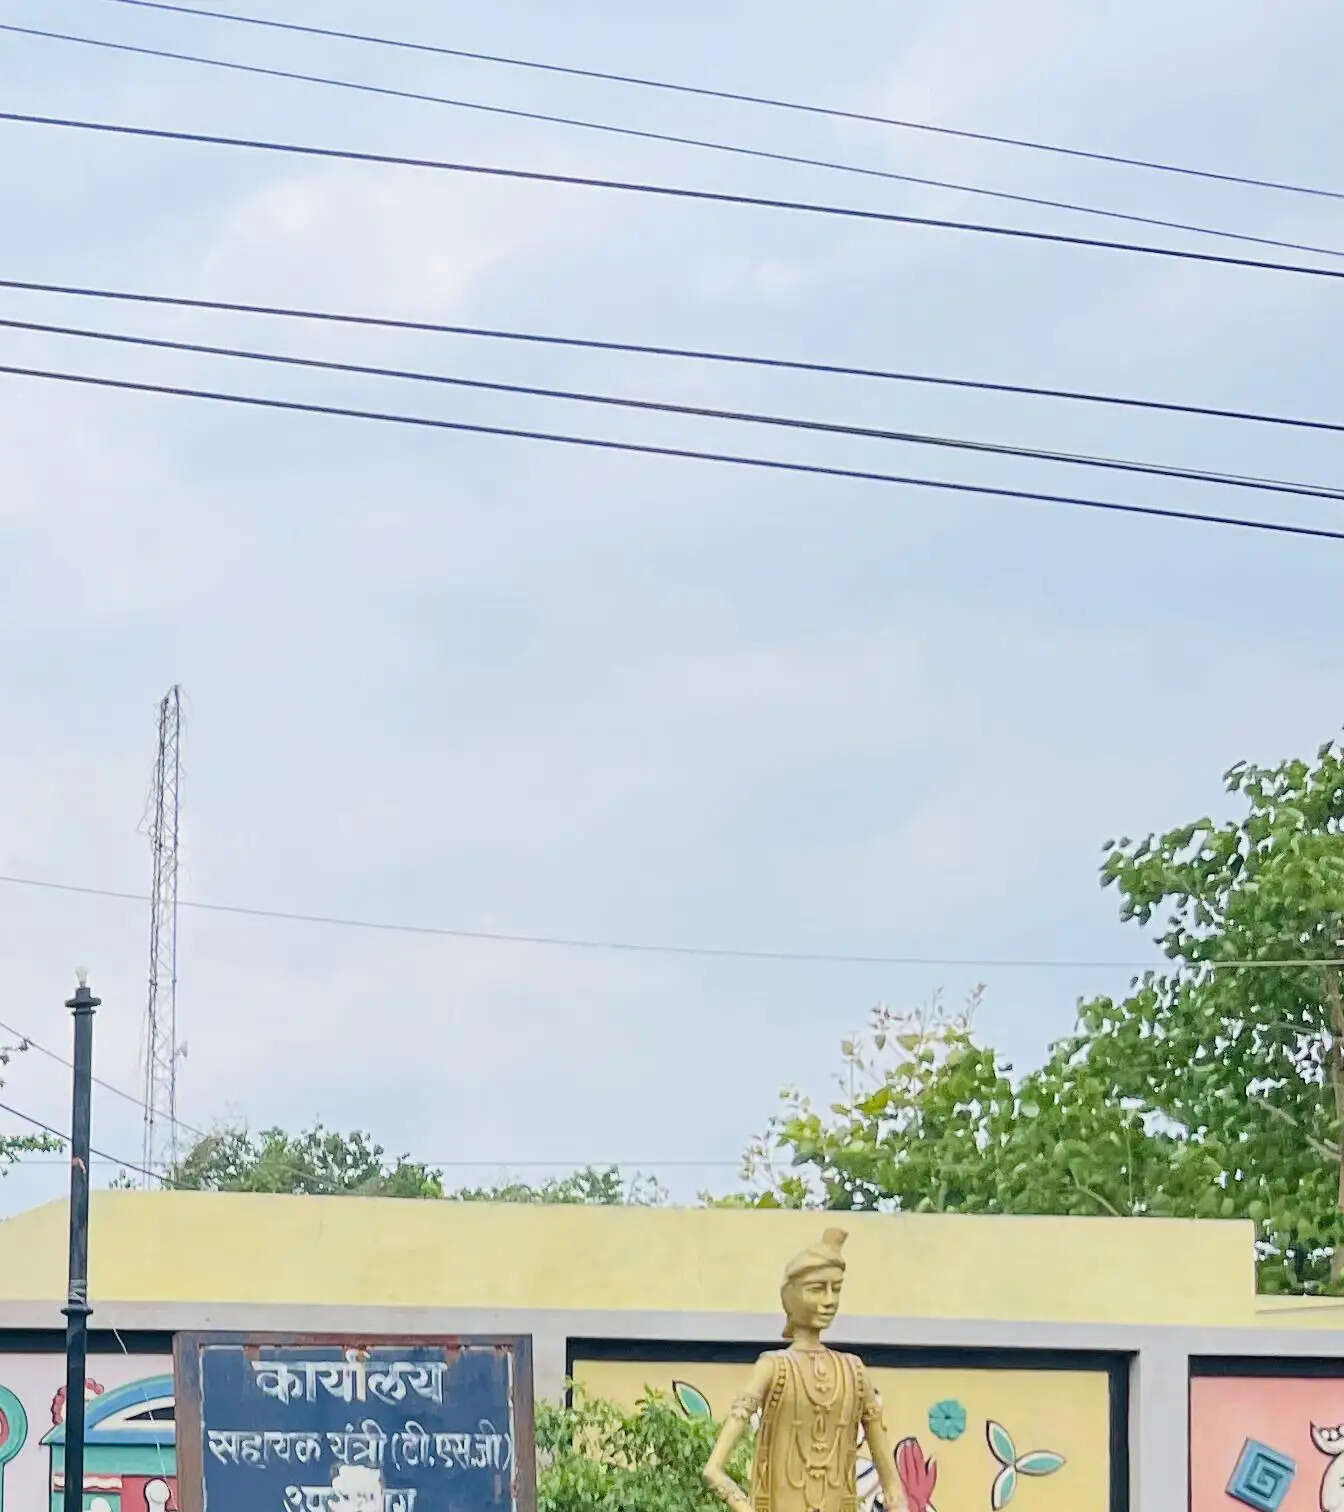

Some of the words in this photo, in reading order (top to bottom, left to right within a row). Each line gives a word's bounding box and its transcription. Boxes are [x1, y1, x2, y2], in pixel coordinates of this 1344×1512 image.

[251, 1350, 448, 1405] कार्यालय
[208, 1430, 321, 1468] सहायक
[327, 1418, 386, 1467] यंत्री
